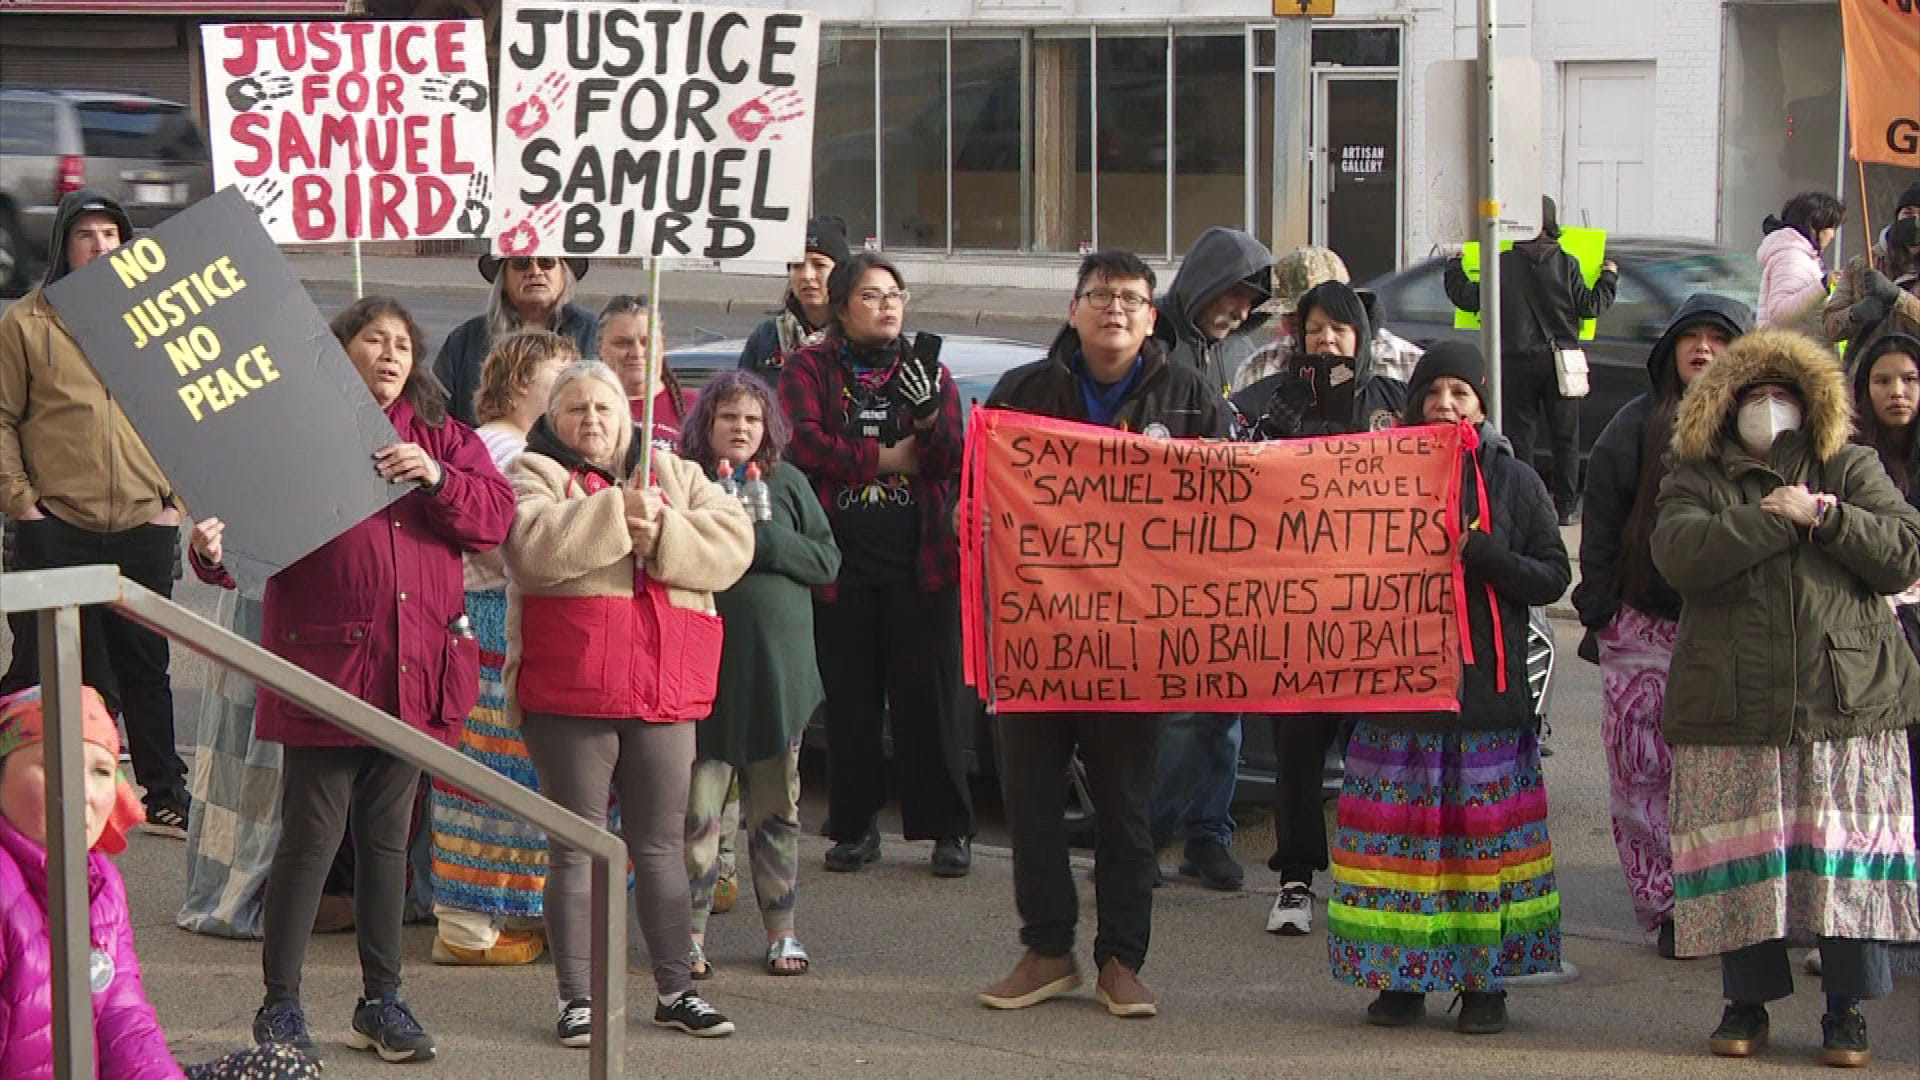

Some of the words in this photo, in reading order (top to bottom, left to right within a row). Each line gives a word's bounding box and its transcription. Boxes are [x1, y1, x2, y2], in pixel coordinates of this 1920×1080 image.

[222, 22, 466, 77] JUSTICE
[508, 8, 803, 86] JUSTICE
[302, 71, 405, 116] FOR
[575, 77, 720, 142] FOR
[230, 110, 474, 177] SAMUEL
[1341, 159, 1383, 173] GALLERY
[1342, 145, 1385, 159] ARTISAN
[519, 138, 789, 221] SAMUEL
[292, 172, 456, 240] BIRD
[563, 202, 755, 258] BIRD
[109, 238, 167, 289] NO
[122, 255, 248, 349] JUSTICE
[163, 325, 221, 377] NO
[177, 345, 281, 423] PEACE
[1011, 436, 1080, 467] SAY
[1099, 437, 1149, 465] HIS
[1339, 456, 1384, 476] FOR
[1023, 469, 1164, 505] "SAMUEL
[1000, 591, 1138, 625] SAMUEL
[1144, 580, 1319, 620] DESERVES
[1003, 637, 1039, 672] NO
[1158, 627, 1200, 670] NO
[1307, 620, 1345, 664] NO
[995, 674, 1141, 702] SAMUEL
[1155, 671, 1248, 700] BIRD
[1272, 665, 1440, 696] MATTERS
